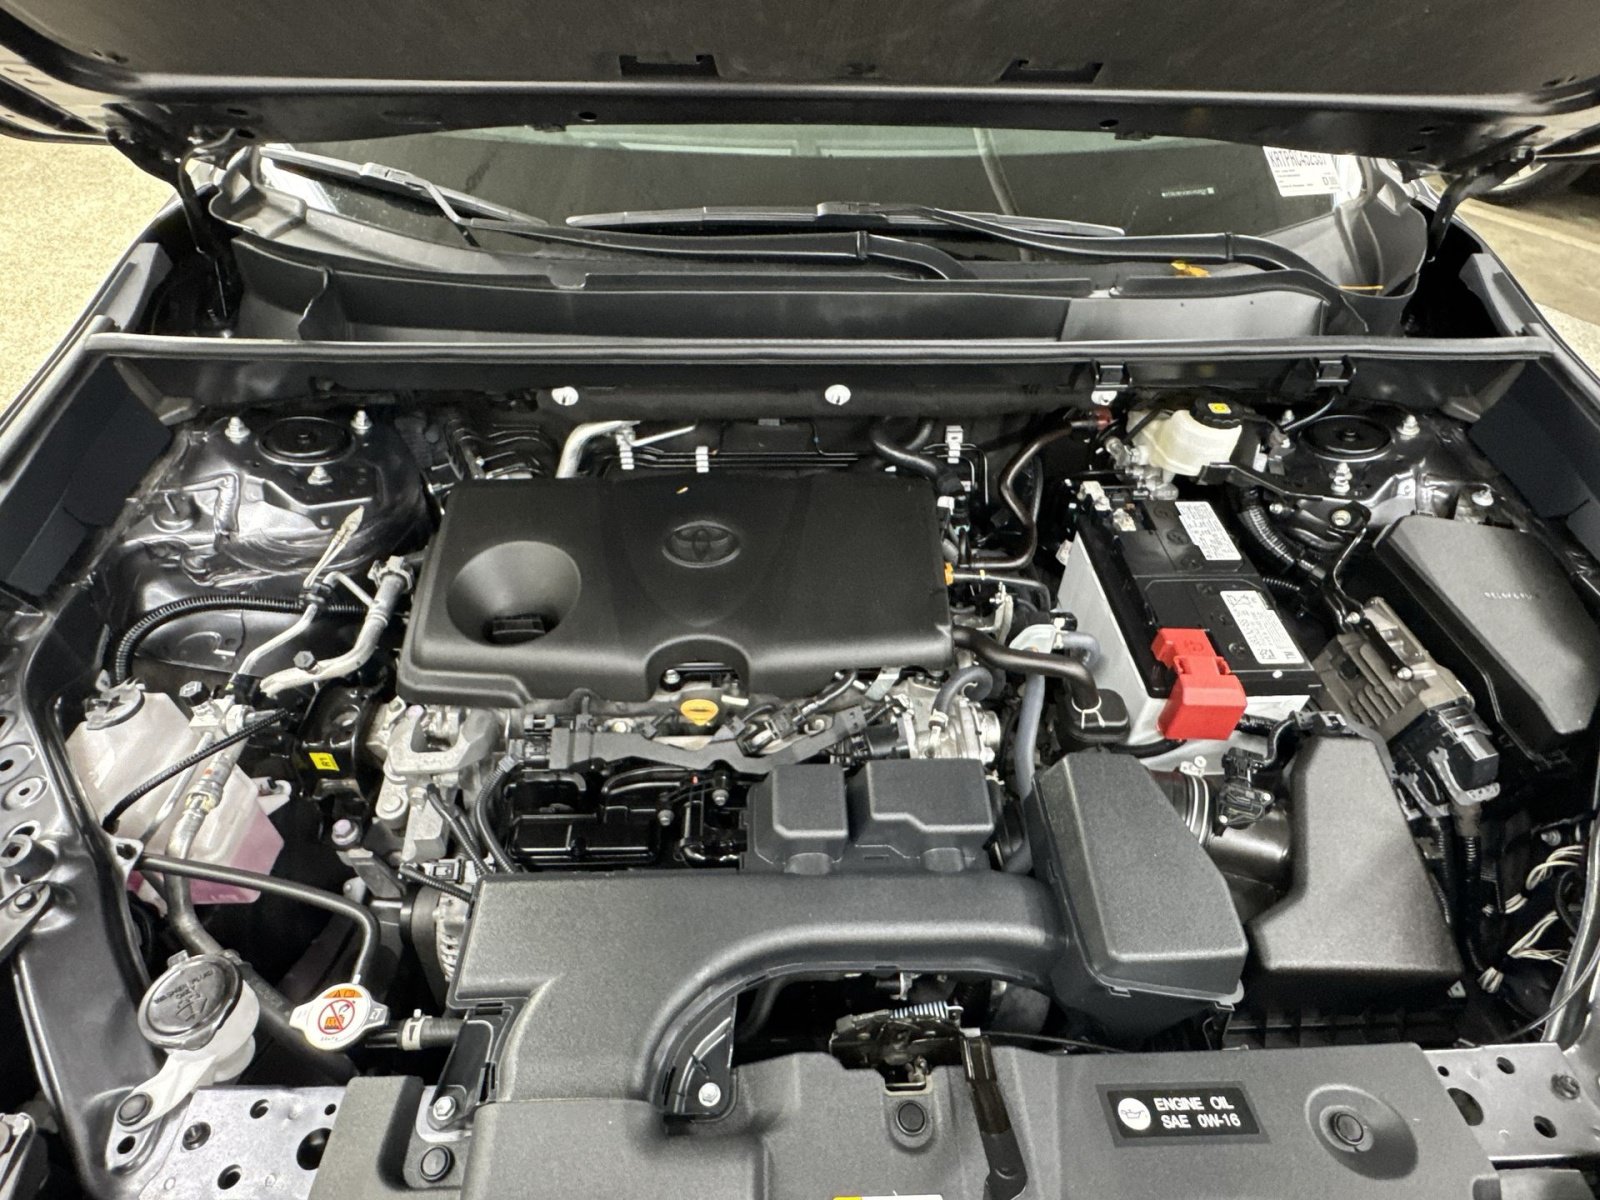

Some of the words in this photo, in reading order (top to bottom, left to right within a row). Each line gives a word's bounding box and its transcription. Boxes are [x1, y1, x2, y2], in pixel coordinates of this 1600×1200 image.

[1153, 1097, 1204, 1111] ENGINE
[1210, 1096, 1235, 1110] OIL
[1161, 1115, 1191, 1128] SAE
[1197, 1113, 1241, 1128] 0W-16
